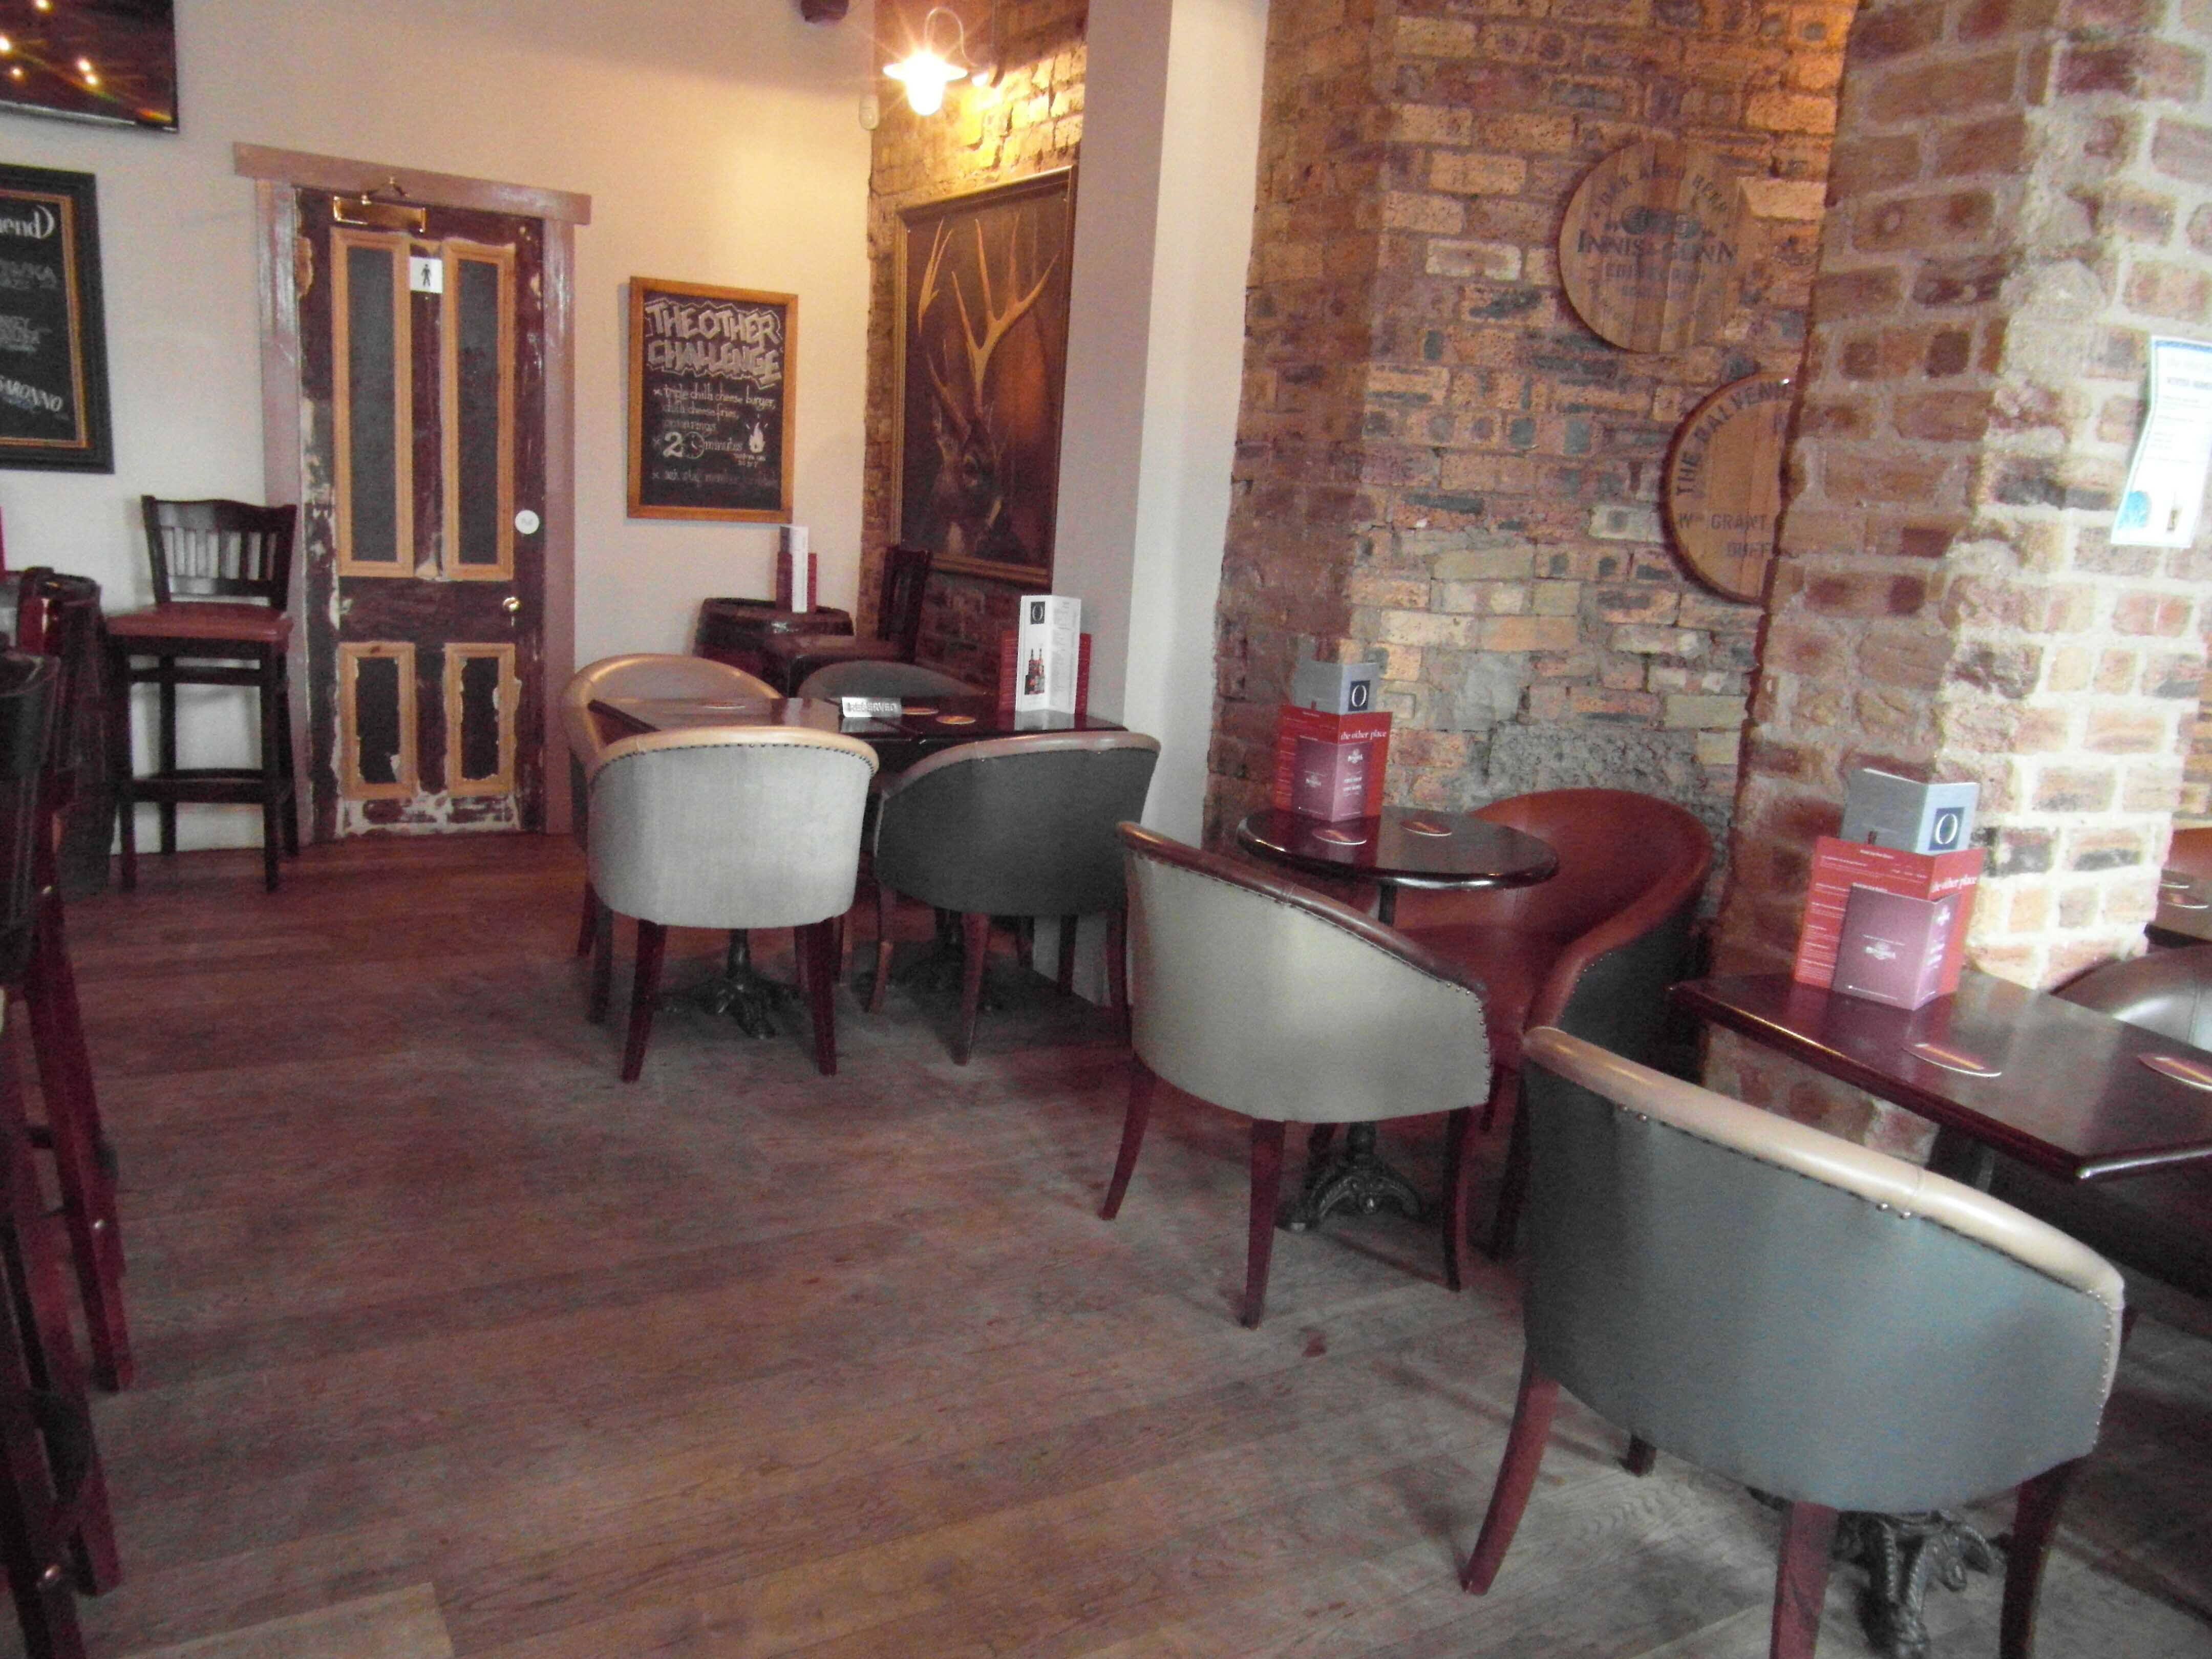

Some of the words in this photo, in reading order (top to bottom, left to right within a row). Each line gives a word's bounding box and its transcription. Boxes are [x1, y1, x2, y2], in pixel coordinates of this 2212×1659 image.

[645, 302, 699, 340] THE
[698, 309, 780, 345] OTHER
[648, 339, 782, 385] CHALLENGE
[847, 701, 898, 713] RESERVED
[1341, 730, 1351, 740] the
[1351, 729, 1369, 739] other
[1369, 728, 1387, 741] place
